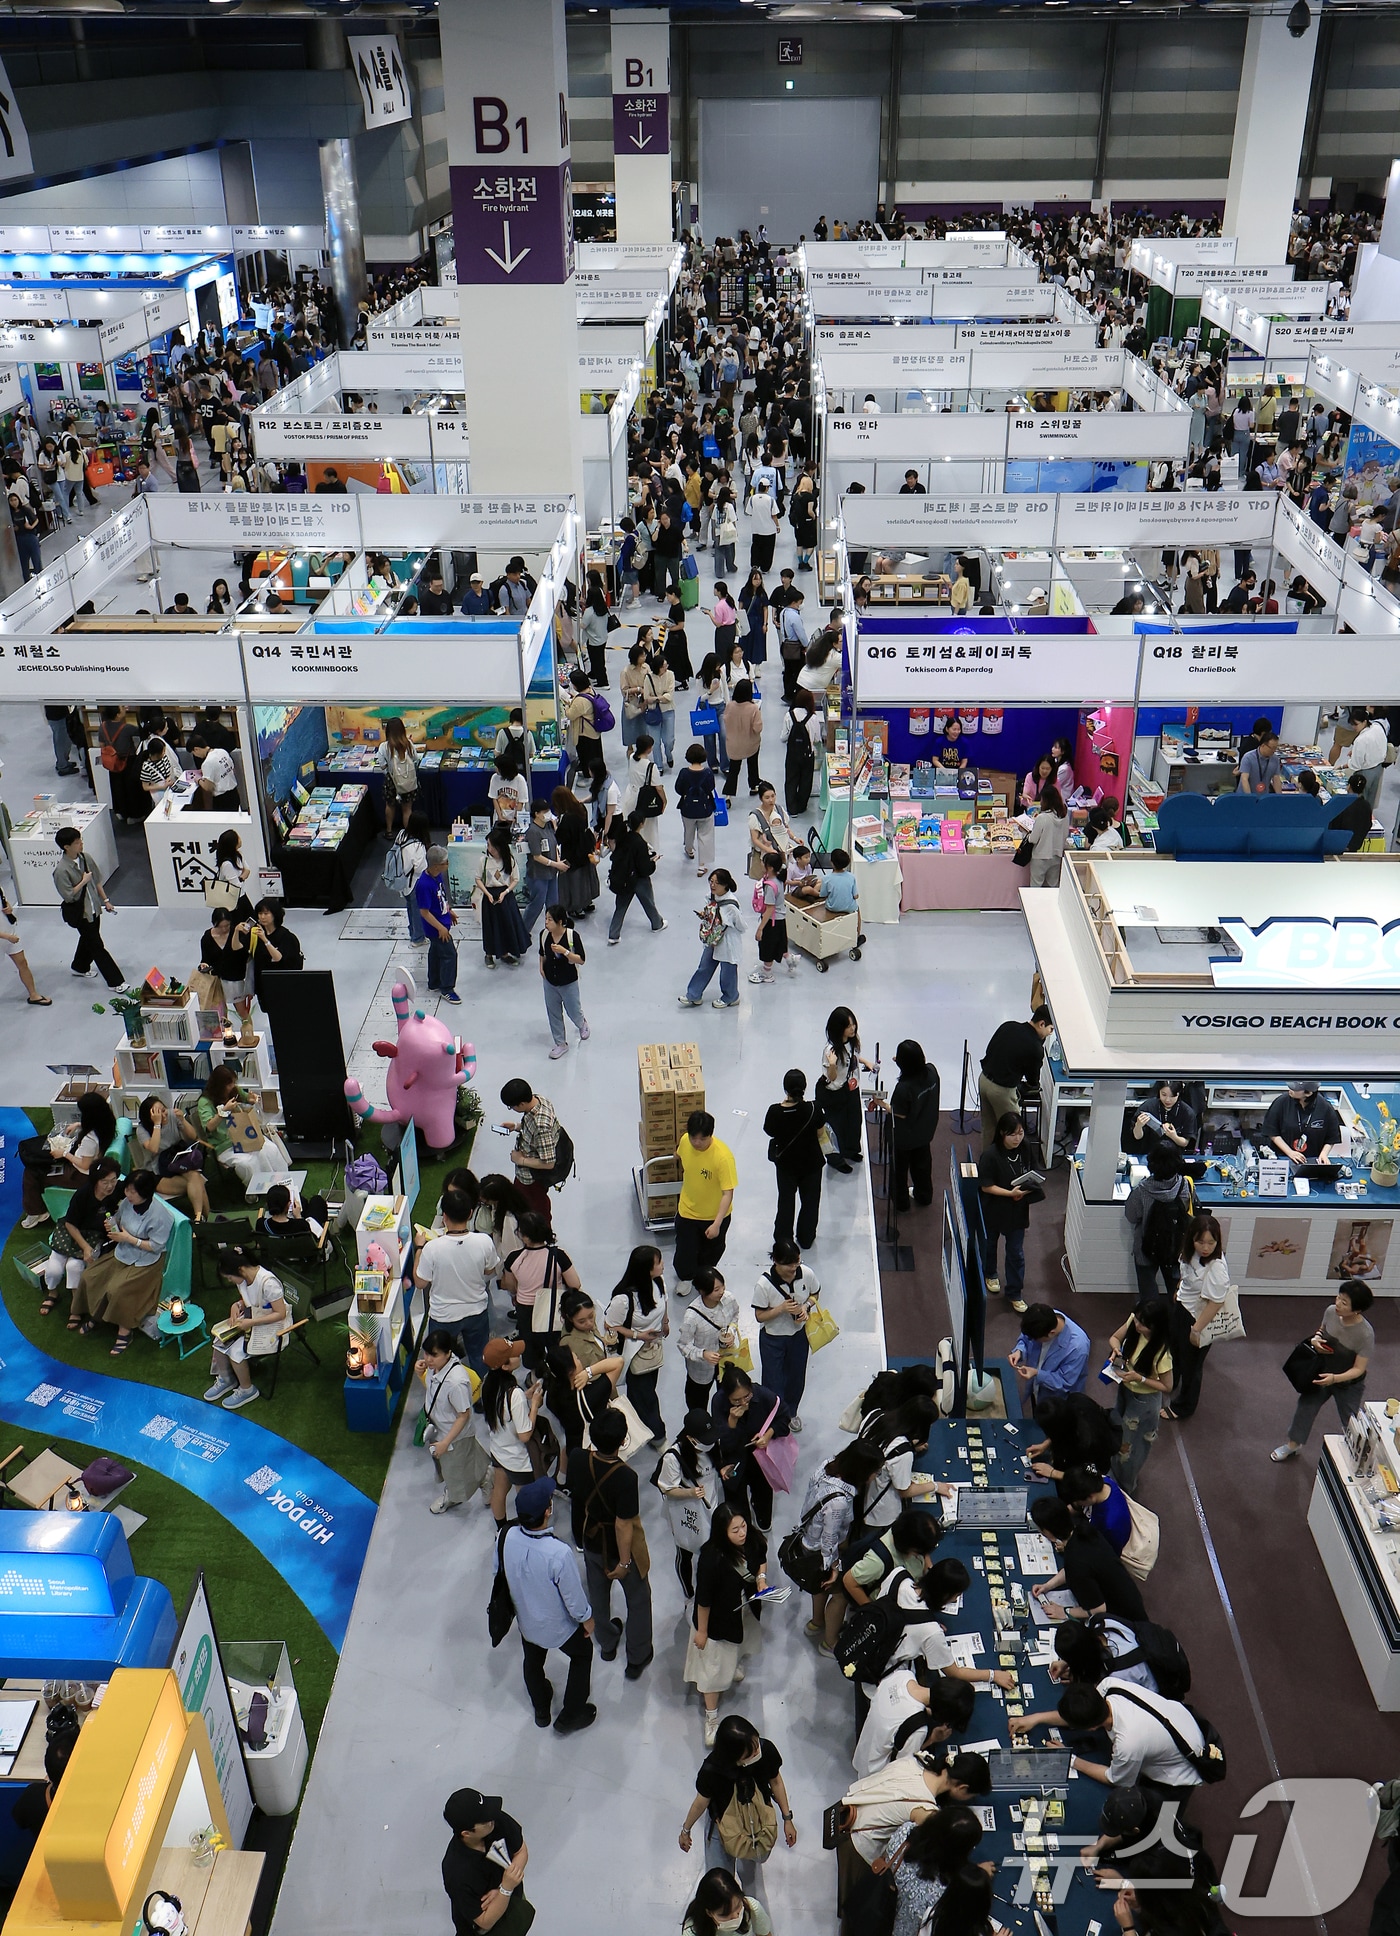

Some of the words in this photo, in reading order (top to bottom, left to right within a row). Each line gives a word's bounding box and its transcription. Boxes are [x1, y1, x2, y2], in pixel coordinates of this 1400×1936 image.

[625, 58, 653, 87] B1
[624, 99, 657, 112] 소화전
[473, 97, 529, 154] B1
[472, 177, 538, 203] 소화전
[482, 204, 499, 212] Fire
[500, 204, 529, 214] hydrant
[391, 332, 422, 340] 티라미수
[820, 331, 834, 339] S16
[1295, 327, 1327, 336] 도서출판
[1330, 327, 1354, 336] 시금치
[200, 403, 214, 417] 95
[259, 421, 277, 430] R12
[283, 421, 323, 430] 보스토크
[332, 421, 383, 431] 프리즘오브
[437, 421, 456, 431] R14
[833, 421, 852, 430] R16
[1015, 420, 1034, 429] R18
[1040, 419, 1082, 430] 스위밍꿀
[13, 644, 61, 658] 제철소
[252, 646, 281, 659] Q14
[290, 644, 353, 660] 국민서관
[867, 646, 897, 659] Q16
[905, 645, 1032, 660] 토끼섬&페이퍼독
[1153, 646, 1183, 659] Q18
[1191, 645, 1239, 660] 찰리북
[65, 665, 105, 674] Publishing
[291, 665, 359, 673] KOOKMINBOOKS
[955, 666, 994, 675] Paperdog
[1182, 1015, 1265, 1029] YOSIGO
[1270, 1016, 1332, 1029] BEACH
[1336, 1016, 1388, 1029] BOOK
[266, 1488, 303, 1522] DOK
[295, 1490, 314, 1507] Club
[314, 1504, 333, 1522] Book
[684, 1507, 698, 1518] TAKE
[686, 1516, 696, 1525] MY
[681, 1520, 700, 1535] MONEY
